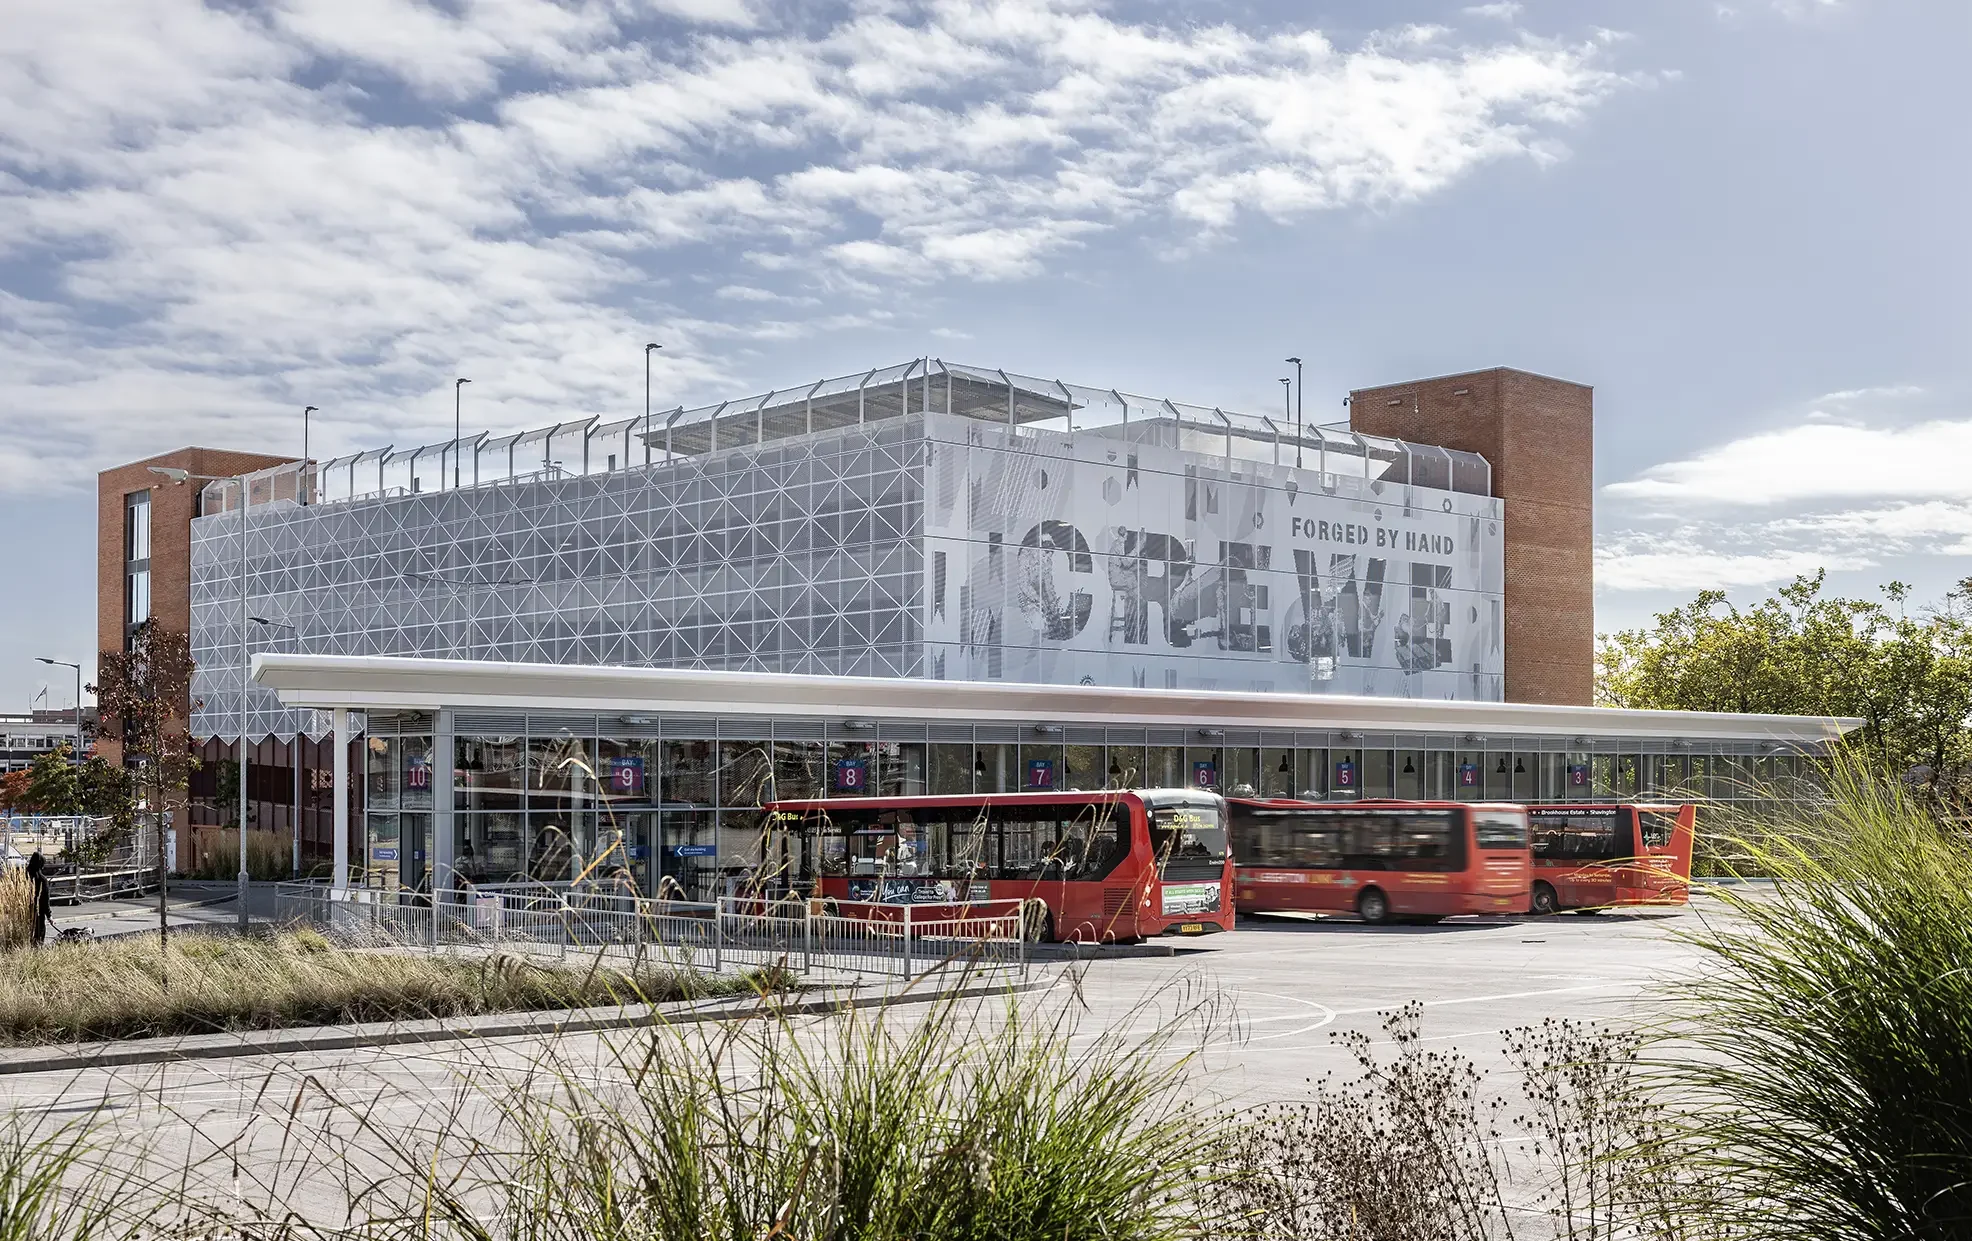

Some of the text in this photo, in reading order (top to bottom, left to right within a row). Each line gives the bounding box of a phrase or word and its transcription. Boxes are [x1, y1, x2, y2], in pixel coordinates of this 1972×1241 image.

[1292, 517, 1454, 555] FORGED BY HAND
[1017, 520, 1453, 667] CREWE
[410, 767, 425, 786] 10
[622, 768, 633, 786] 9
[846, 768, 856, 786] 8
[1036, 769, 1045, 785] 7
[1200, 770, 1207, 785] 6
[1341, 770, 1348, 784] 5
[1465, 771, 1472, 784] 4
[1575, 771, 1581, 784] 3
[1174, 814, 1201, 822] D&G Bus
[897, 885, 910, 894] can
